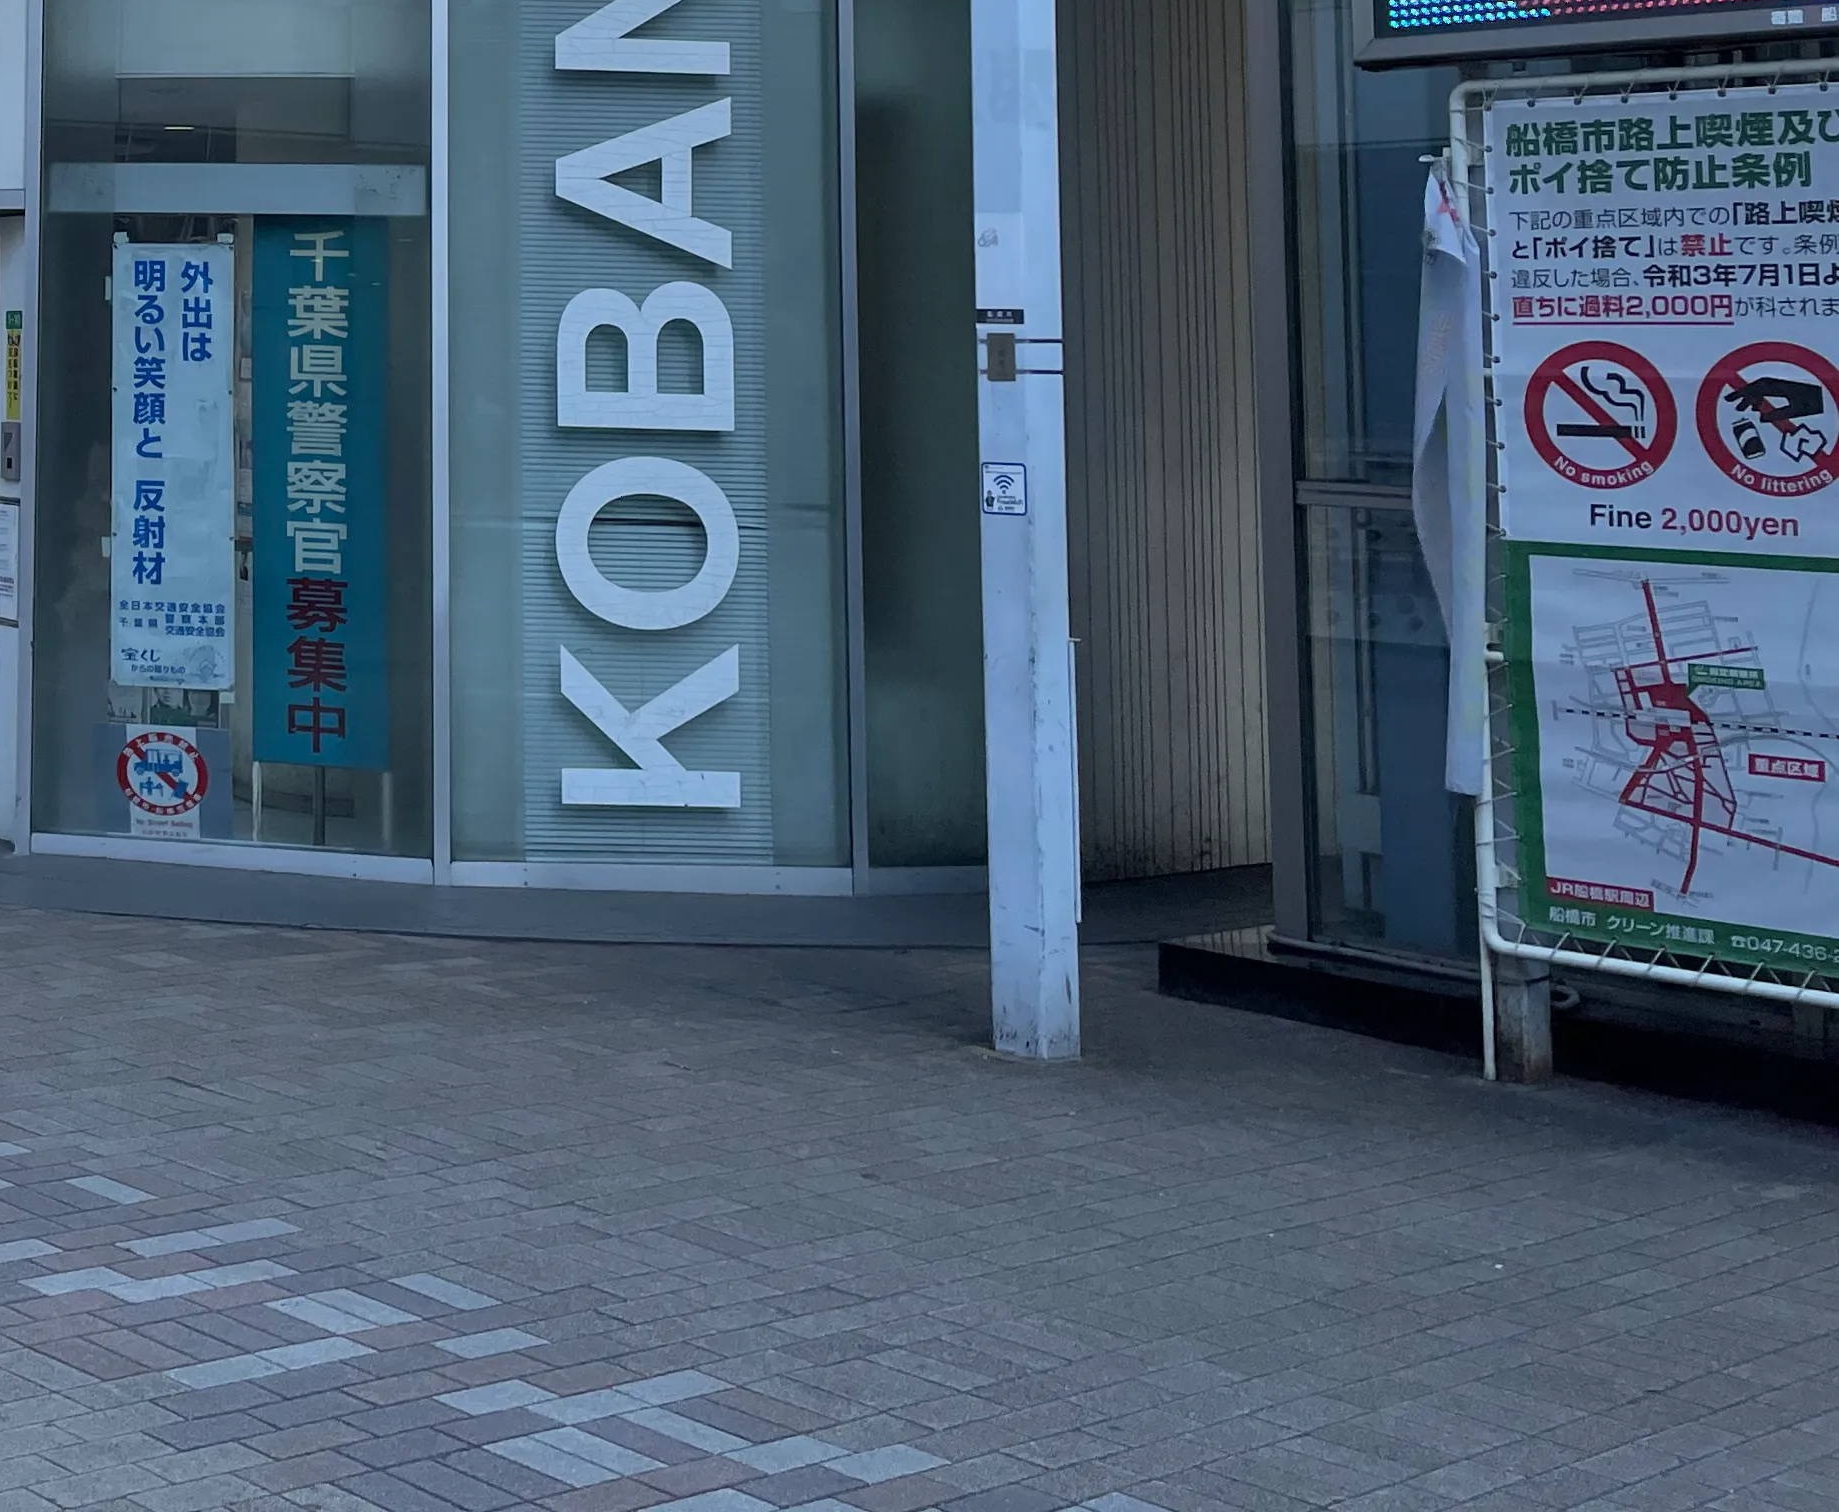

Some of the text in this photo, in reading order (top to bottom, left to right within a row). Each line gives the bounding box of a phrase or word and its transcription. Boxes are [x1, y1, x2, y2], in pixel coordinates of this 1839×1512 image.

[1509, 150, 1812, 195] ポイ捨て防止条例
[181, 261, 213, 363] 外出は
[132, 260, 166, 586] 明るい笑顔と 反射材
[1554, 455, 1655, 487] No smoking
[1730, 463, 1834, 494] No littering
[286, 231, 350, 754] 千葉県警察官募集中
[1589, 503, 1800, 537] Fine 2,000yen
[119, 600, 225, 614] 全日本交通安全協会
[1550, 880, 1650, 908] JR船橋駅周辺
[1549, 907, 1597, 927] 船橋市
[1607, 915, 1716, 945] クリーン推進課
